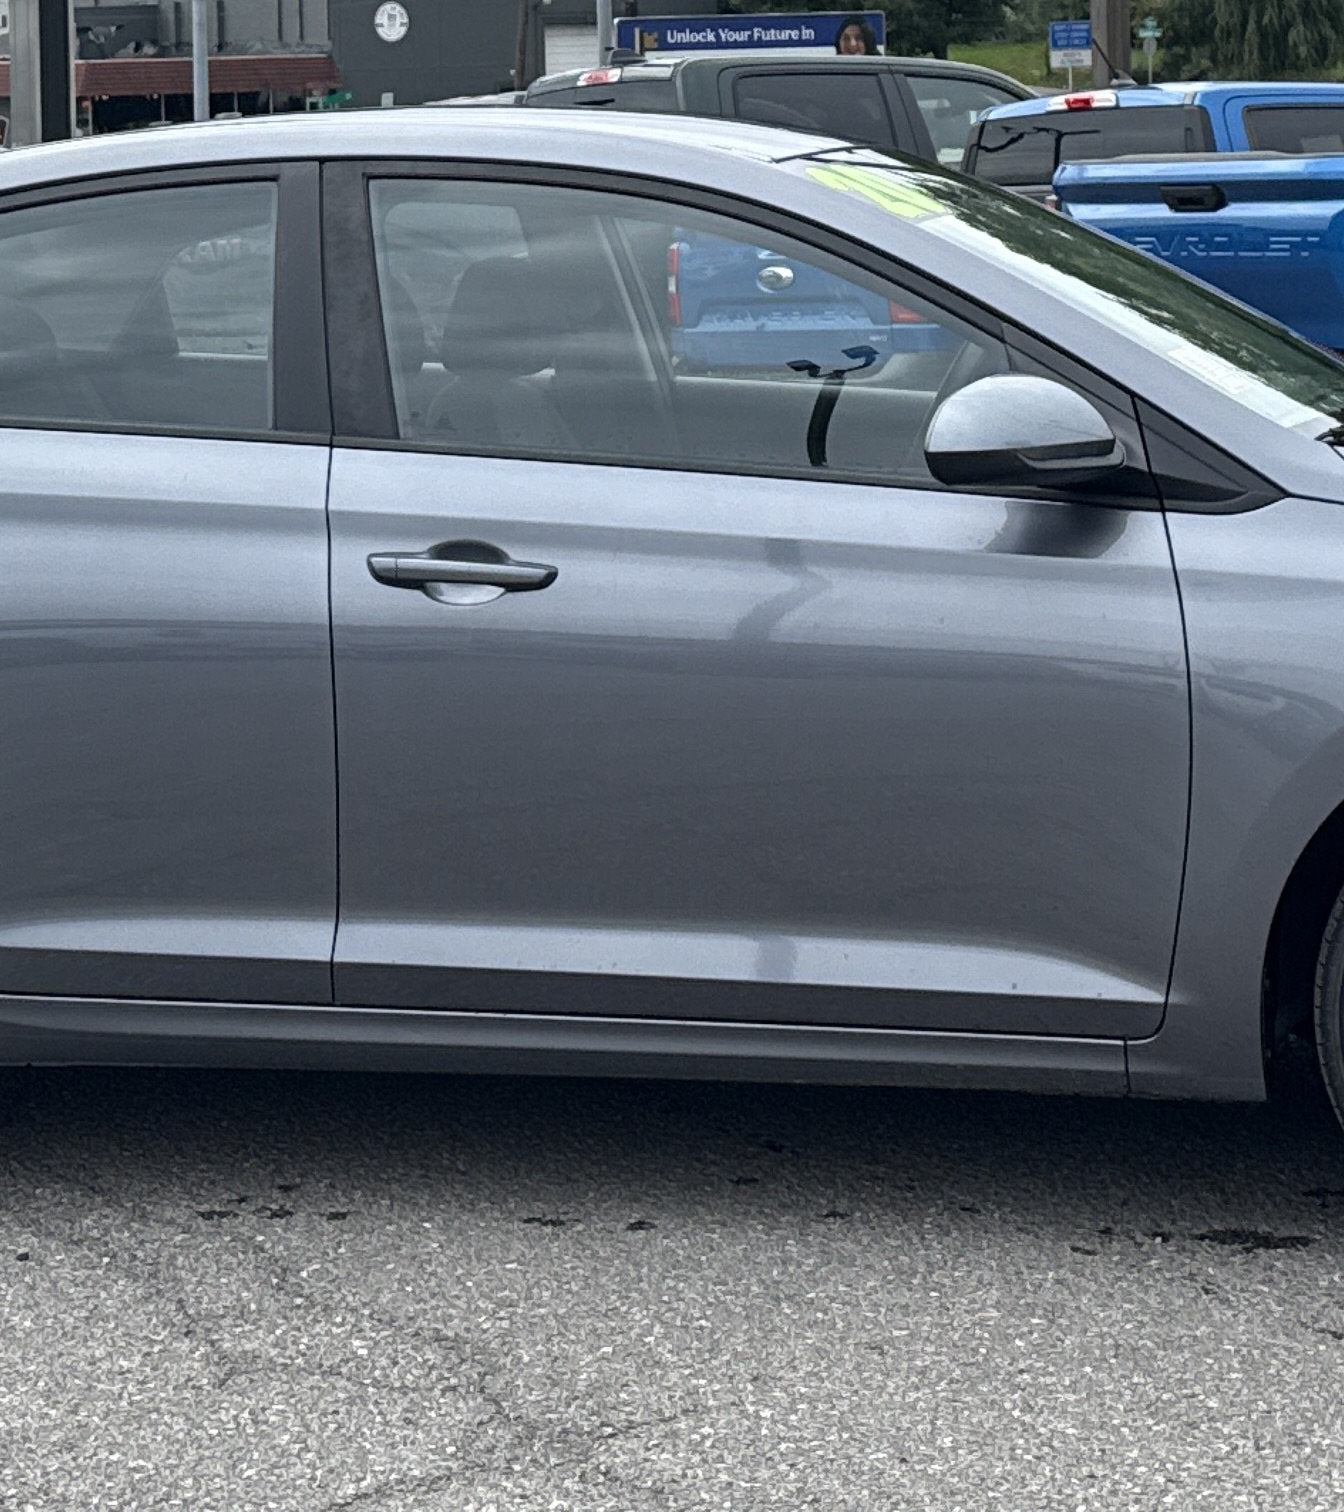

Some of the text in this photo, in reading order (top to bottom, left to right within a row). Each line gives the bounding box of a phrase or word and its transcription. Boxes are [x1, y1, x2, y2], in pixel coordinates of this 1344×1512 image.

[666, 28, 716, 44] Unlock
[718, 28, 752, 42] Your
[753, 26, 799, 41] Future
